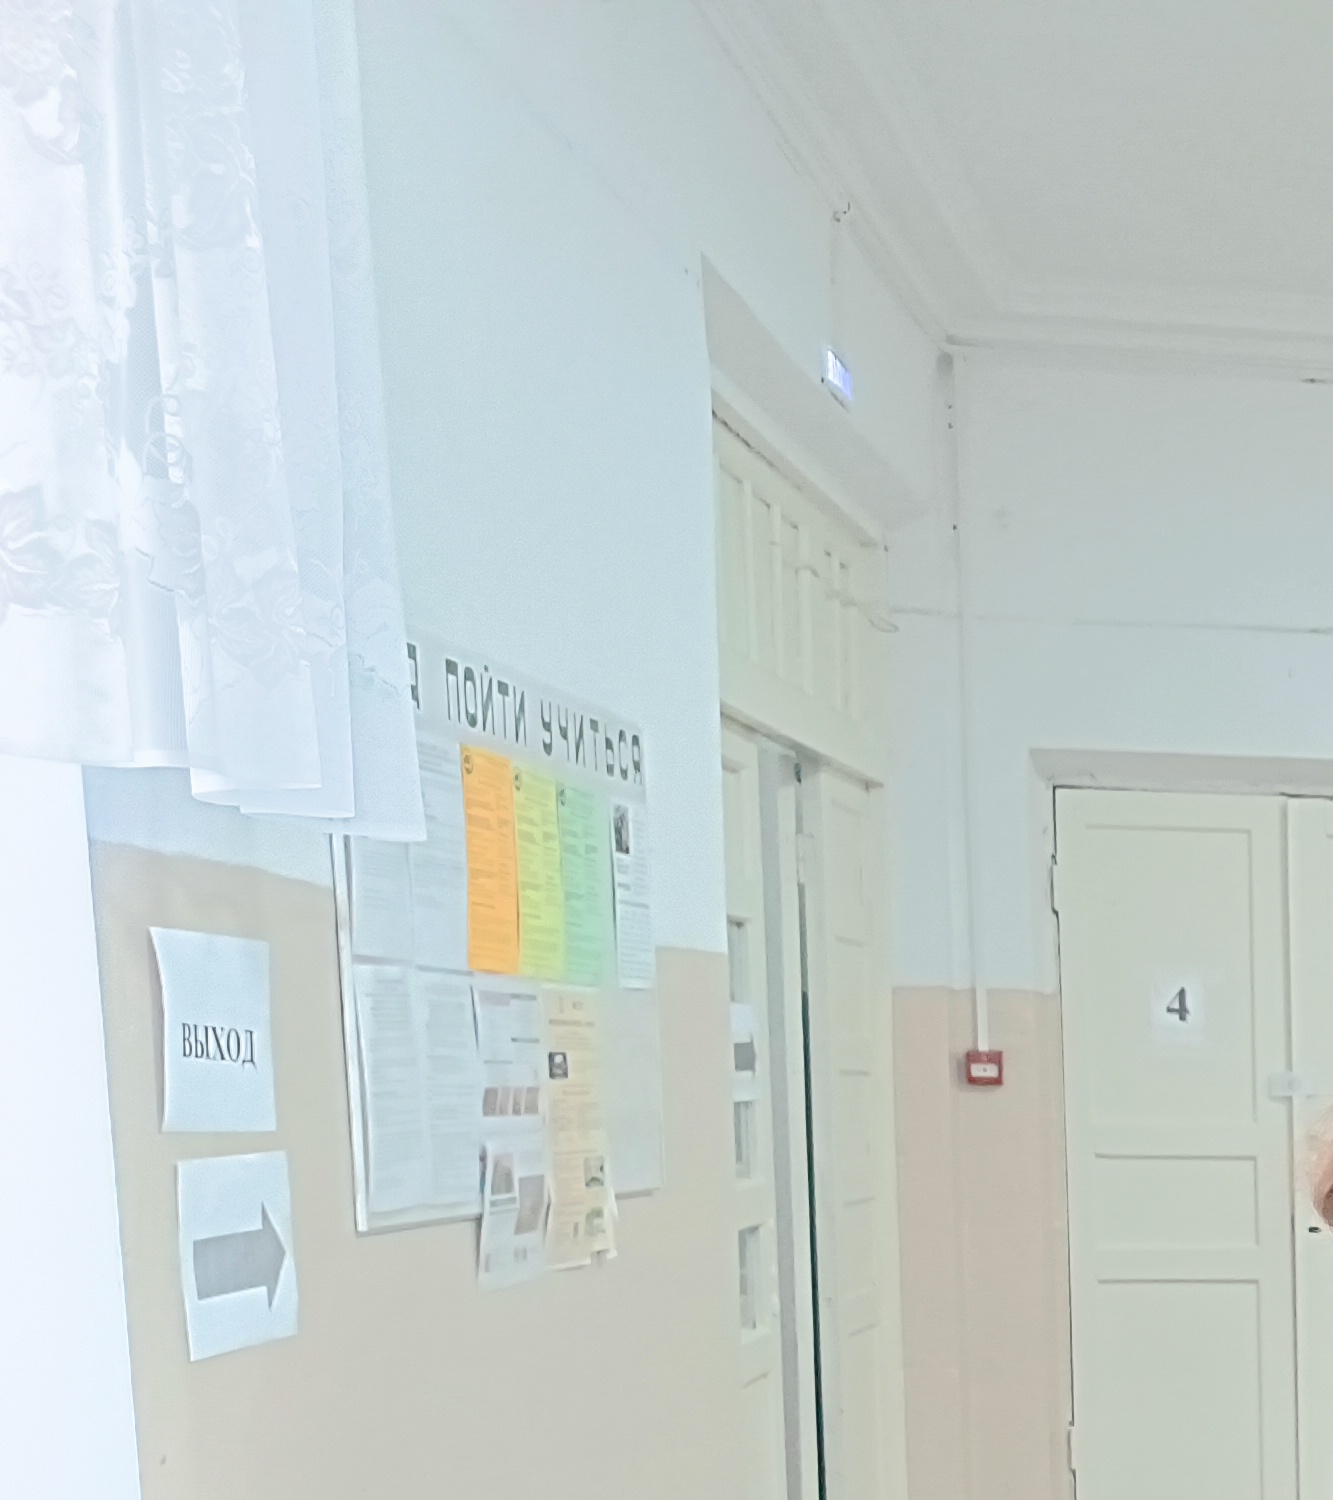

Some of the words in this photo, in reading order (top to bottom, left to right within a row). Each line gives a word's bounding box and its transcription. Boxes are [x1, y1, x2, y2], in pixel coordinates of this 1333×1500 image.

[445, 658, 527, 747] ПОЙТИ
[540, 699, 643, 786] УЧИТЬСЯ
[1165, 986, 1190, 1022] 4
[182, 1022, 257, 1071] ВЫХОД
